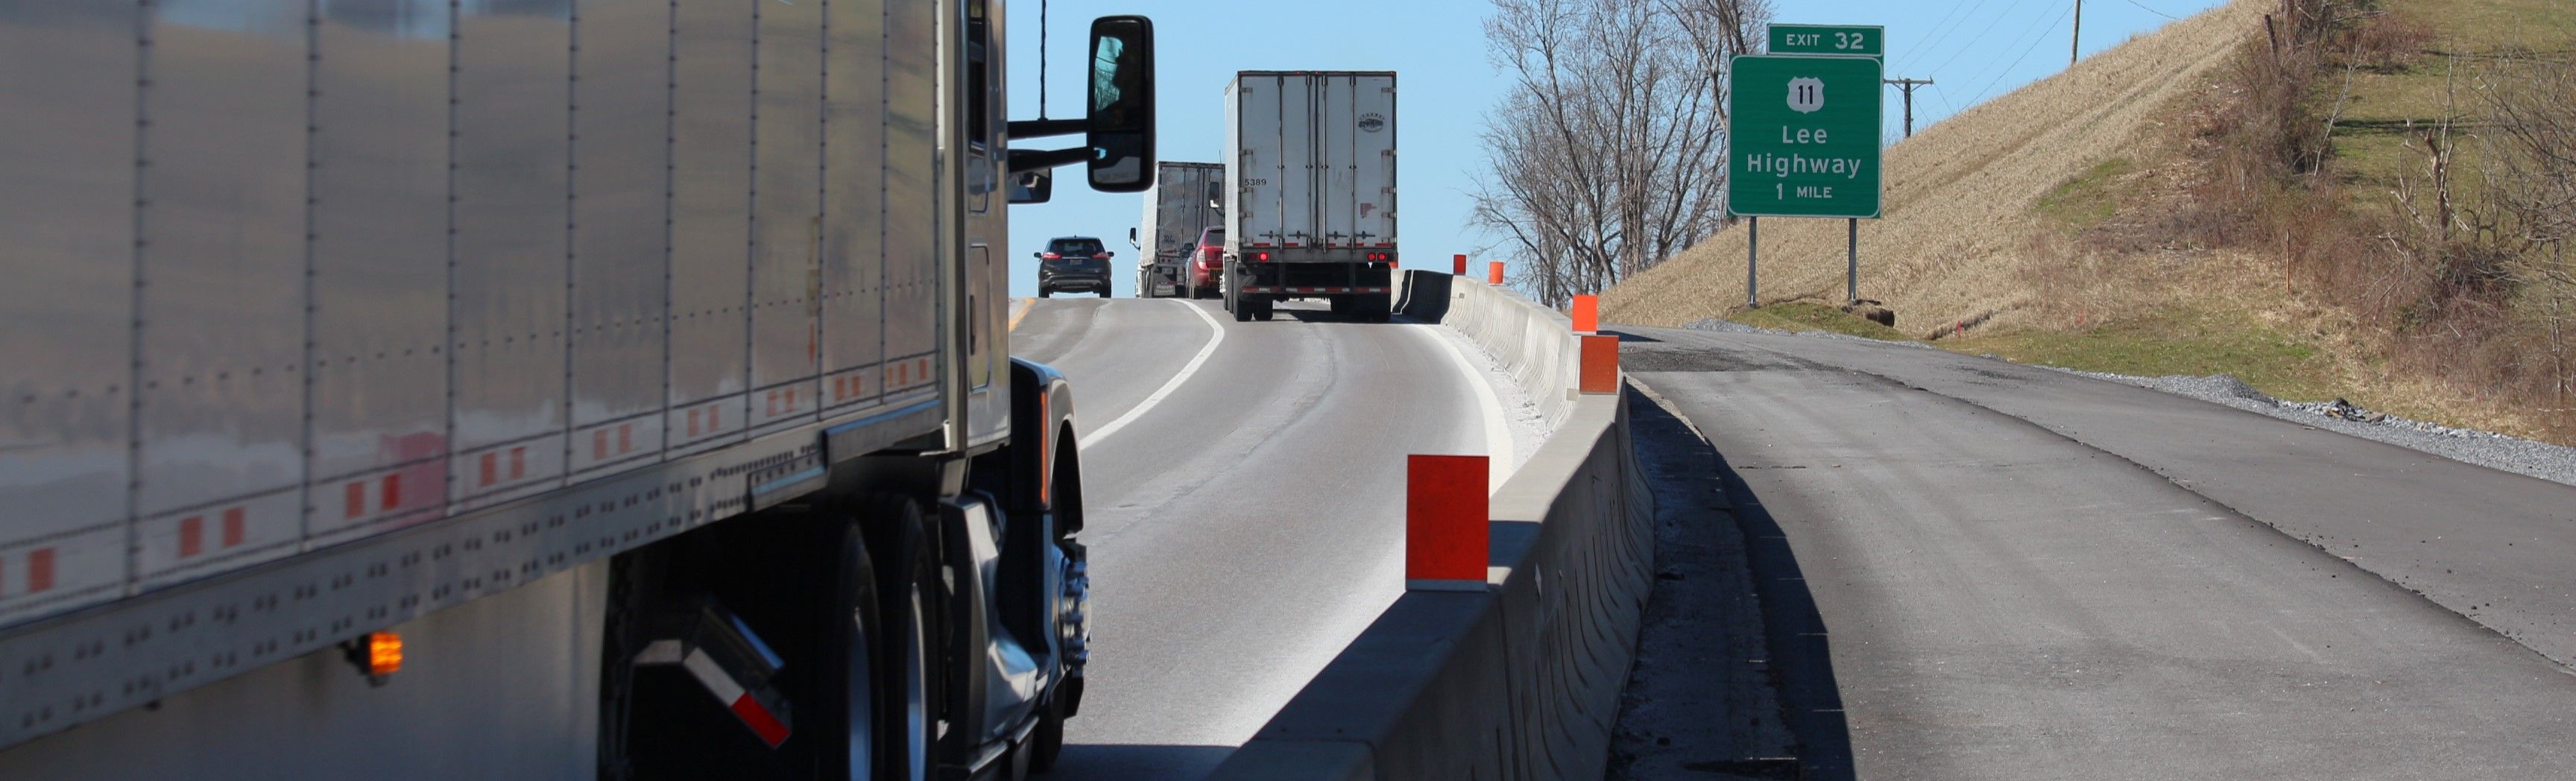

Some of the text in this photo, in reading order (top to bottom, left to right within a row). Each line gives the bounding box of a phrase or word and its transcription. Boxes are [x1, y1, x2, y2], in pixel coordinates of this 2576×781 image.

[1786, 32, 1863, 49] EXIT 32
[1798, 85, 1813, 104] 11
[1782, 125, 1827, 144] Lee
[1747, 153, 1861, 179] Highway
[1245, 178, 1266, 186] 5389
[1776, 183, 1832, 200] 1 MILE
